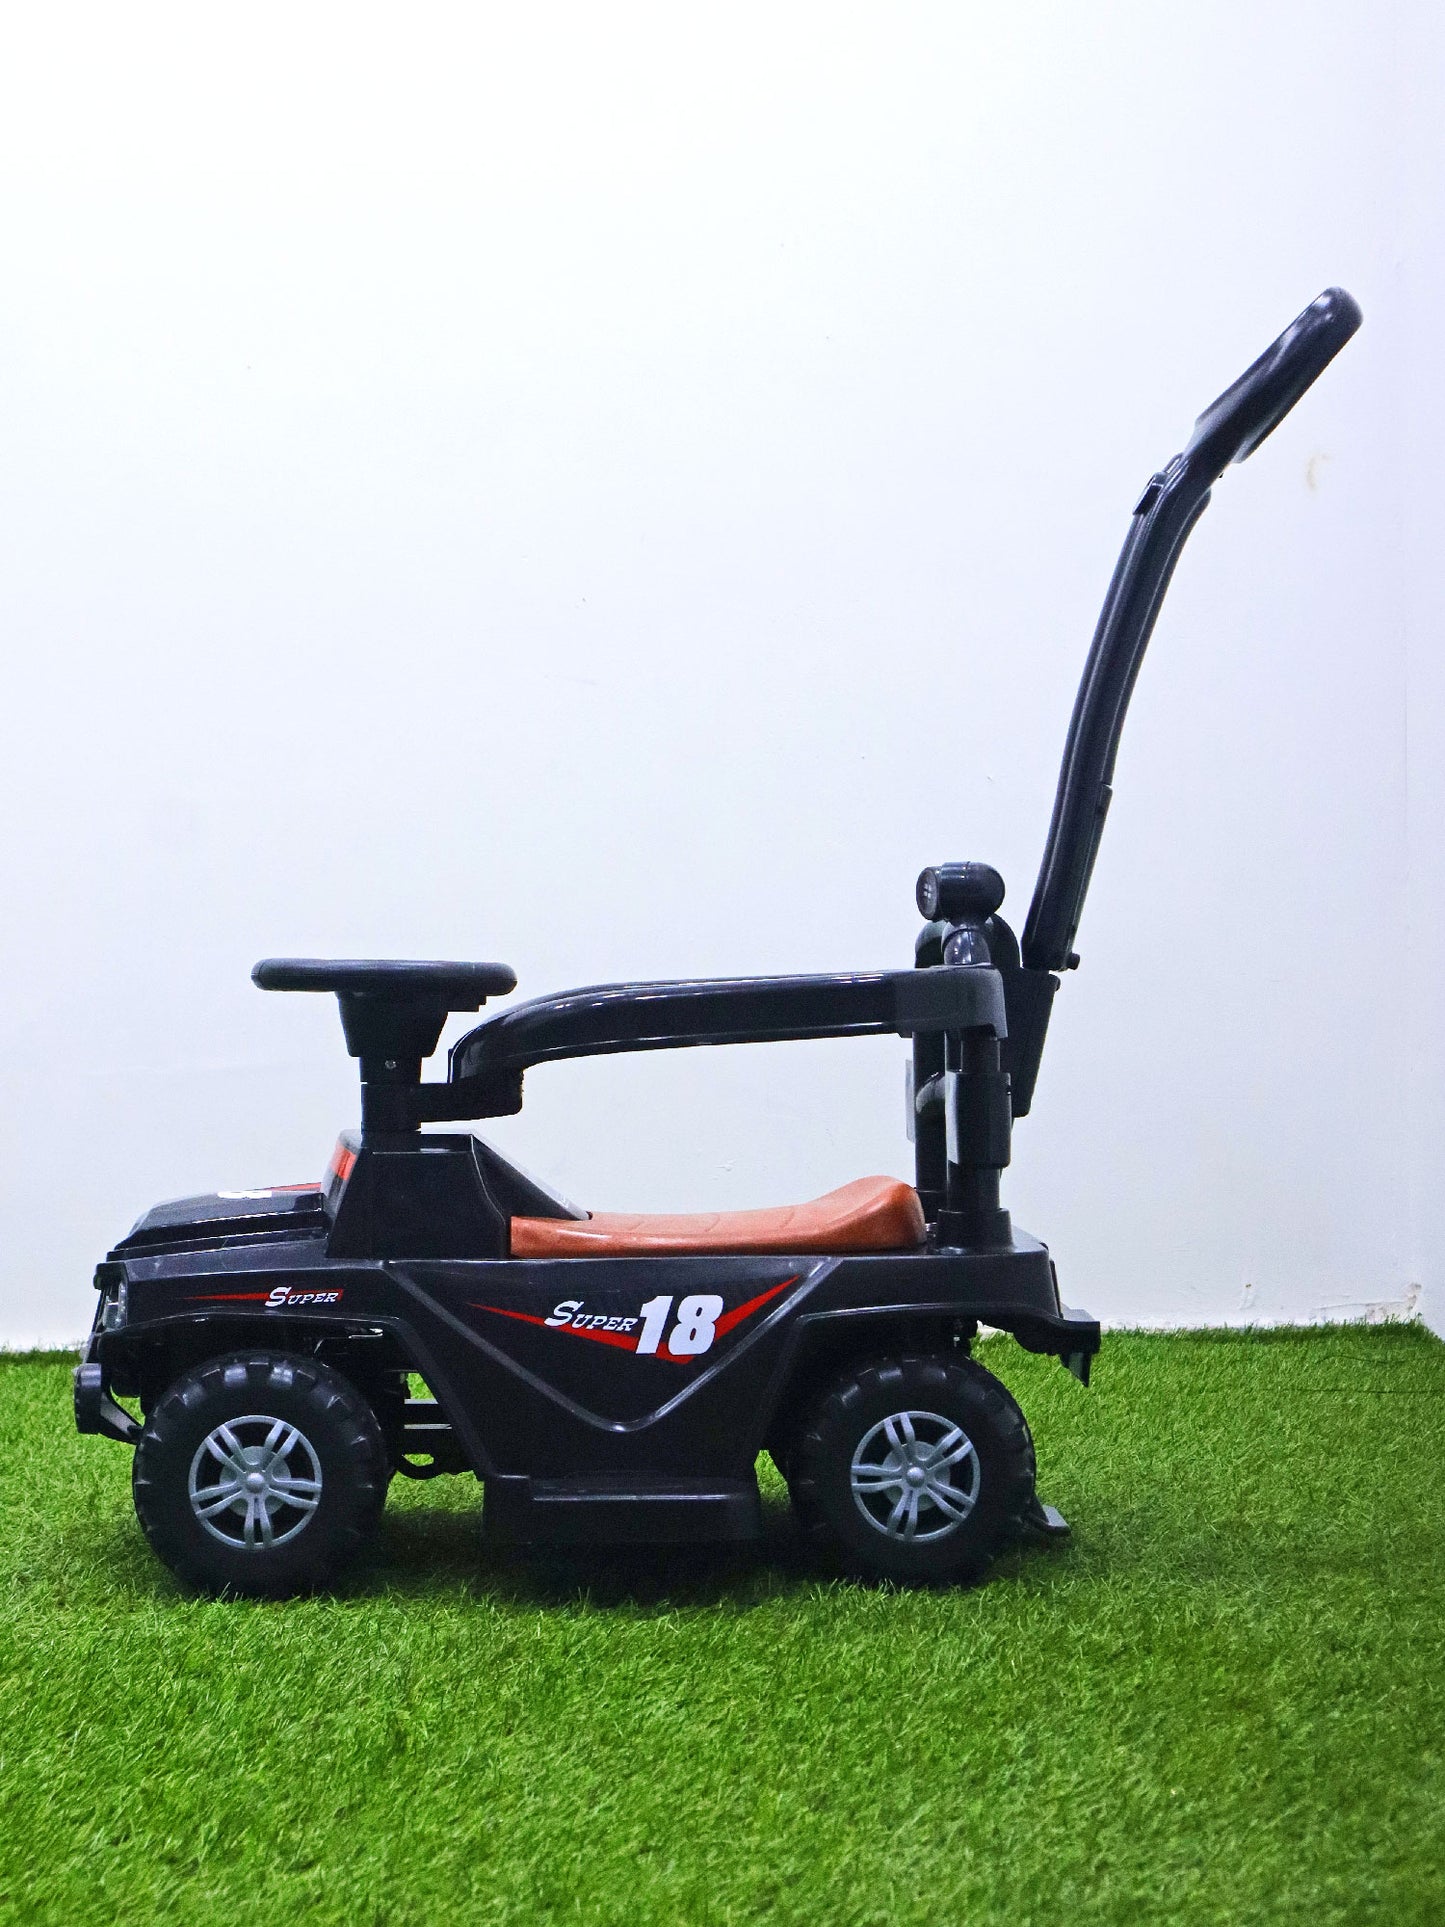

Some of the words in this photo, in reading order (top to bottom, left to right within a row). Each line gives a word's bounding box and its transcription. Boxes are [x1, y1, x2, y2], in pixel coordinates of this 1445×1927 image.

[265, 1286, 339, 1307] SUPER
[544, 1300, 638, 1332] SUPER
[635, 1294, 724, 1355] 18
